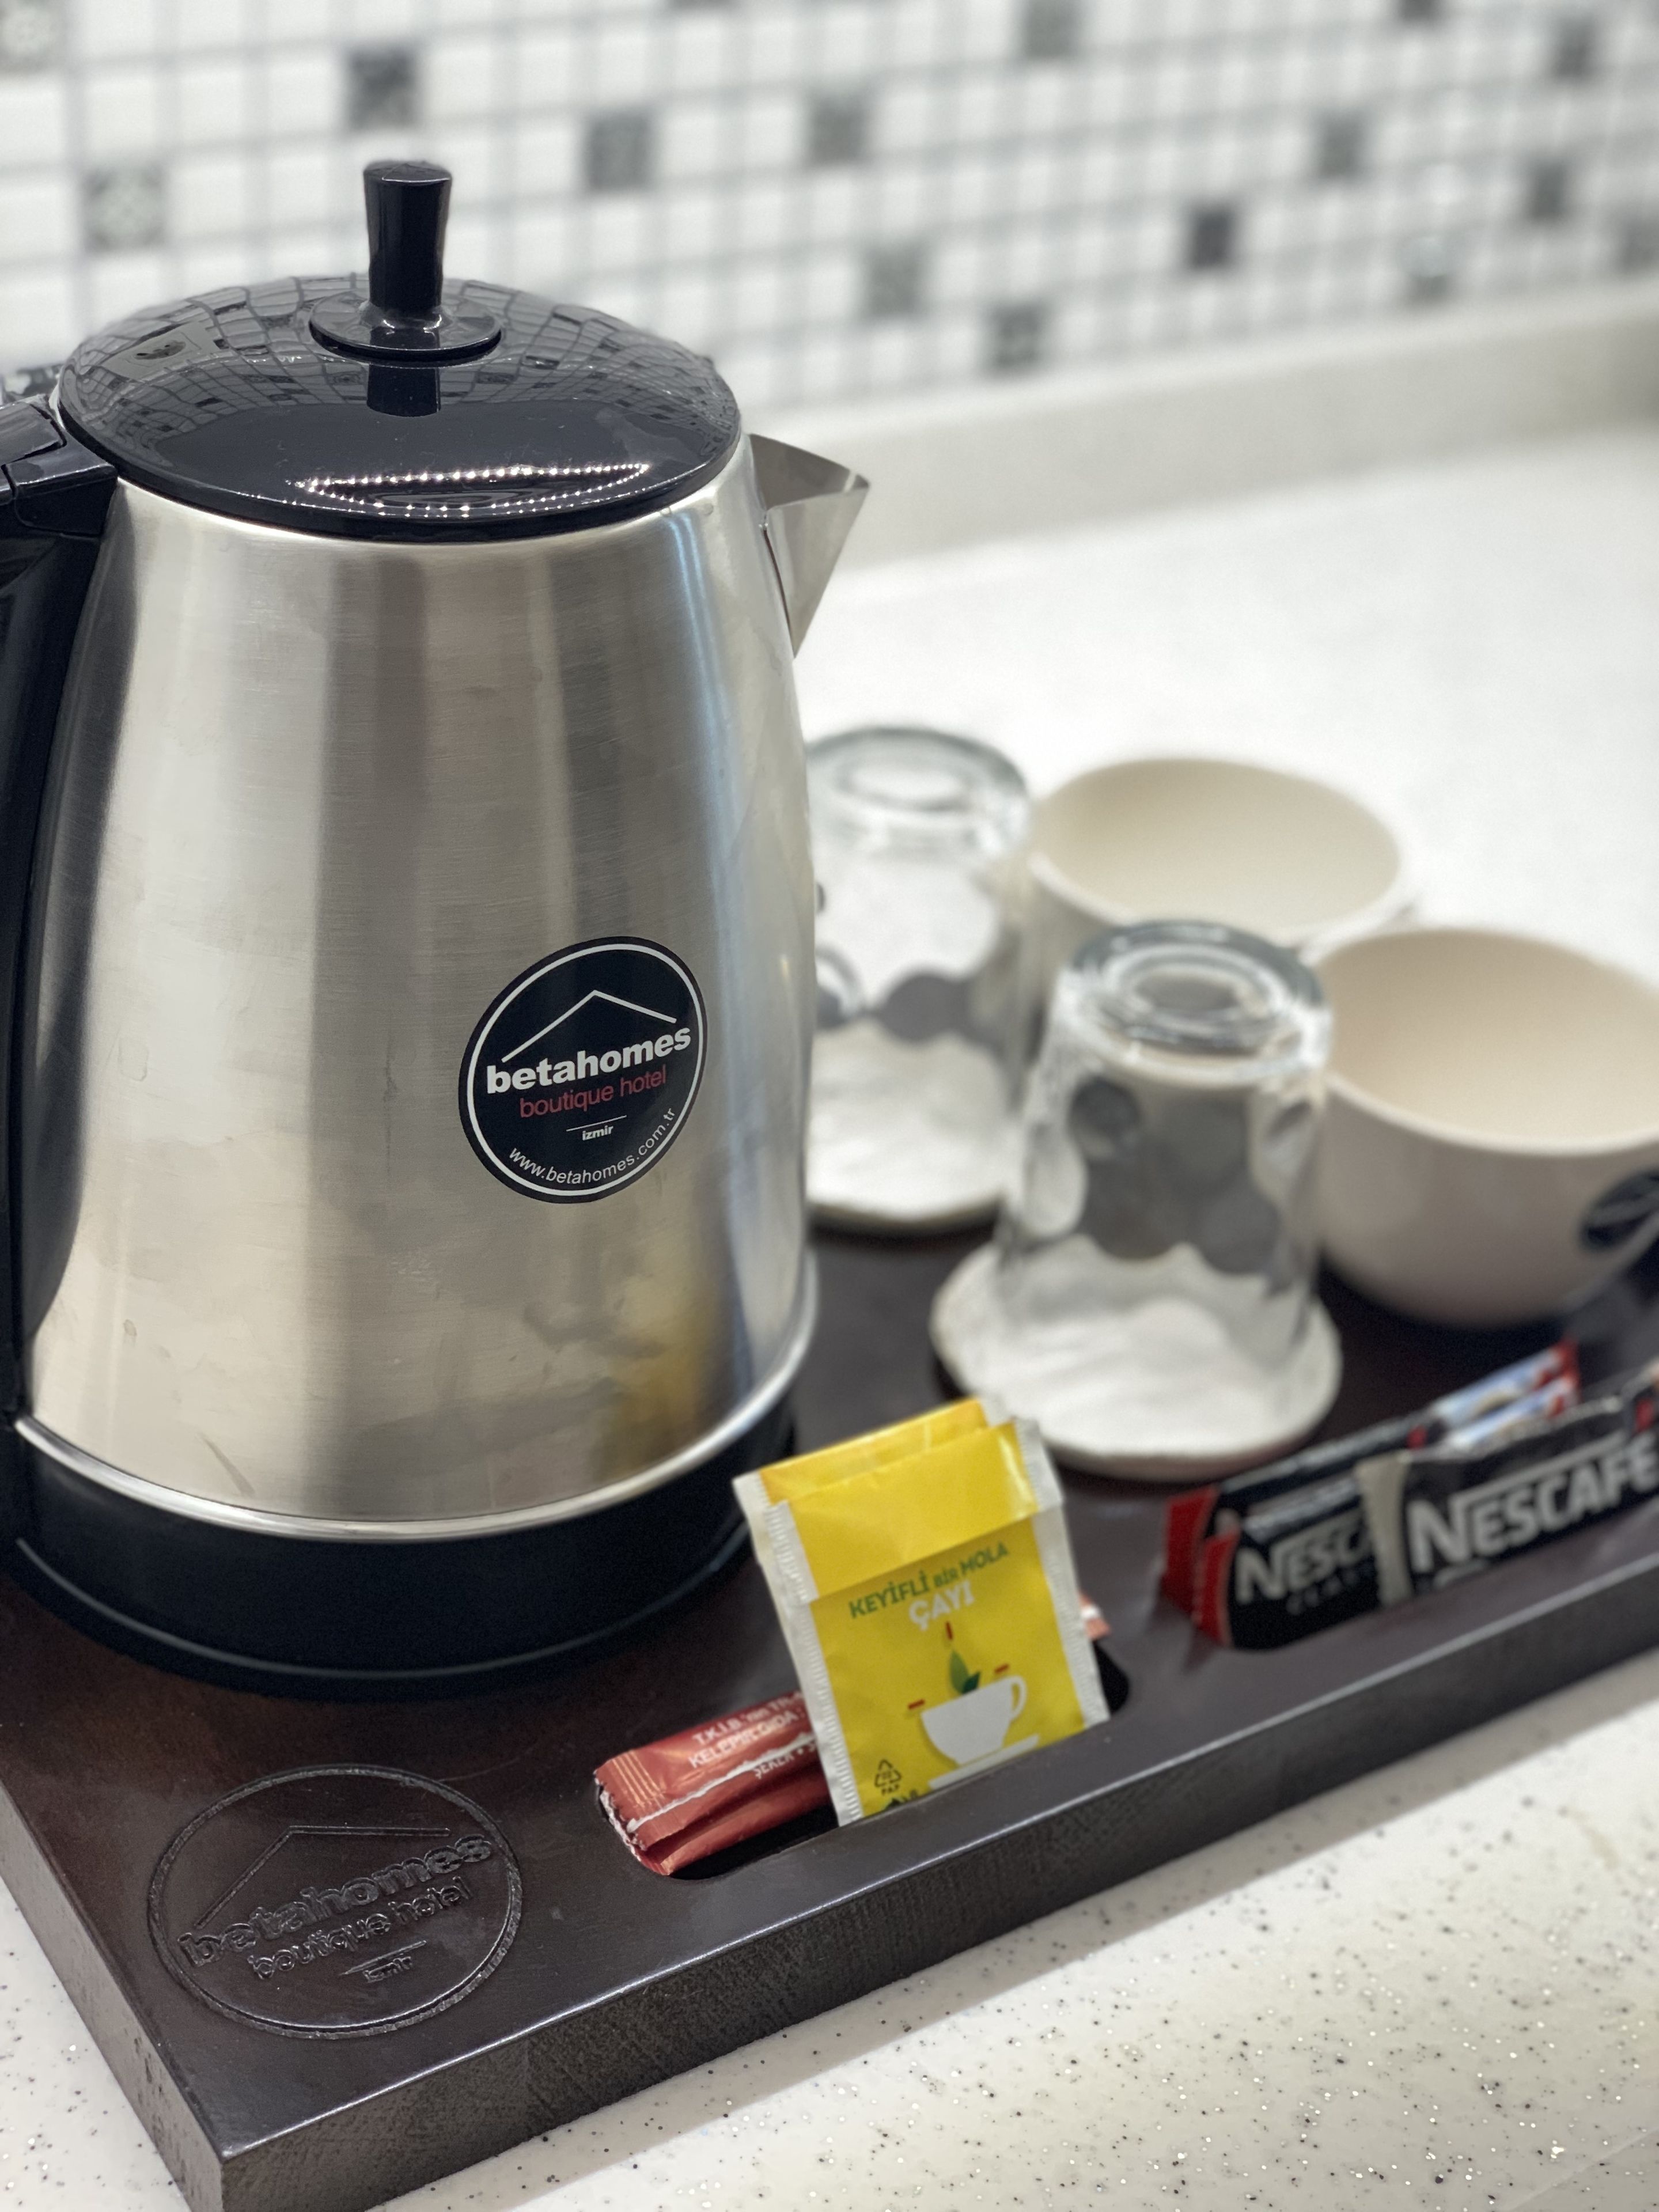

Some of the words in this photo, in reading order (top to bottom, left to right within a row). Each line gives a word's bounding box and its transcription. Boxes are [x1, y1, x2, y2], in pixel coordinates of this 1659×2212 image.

[487, 1027, 692, 1094] betahomes
[520, 1084, 614, 1119] boutique
[620, 1064, 667, 1097] hotel
[509, 1107, 676, 1184] www.betahomes.com.tr
[582, 1124, 614, 1141] izmir
[959, 1540, 1009, 1575] MOLA
[908, 1580, 975, 1632] ÇAYI
[177, 1834, 492, 1967] betahomes
[247, 1912, 392, 1980] boutique
[388, 1876, 472, 1922] hotel
